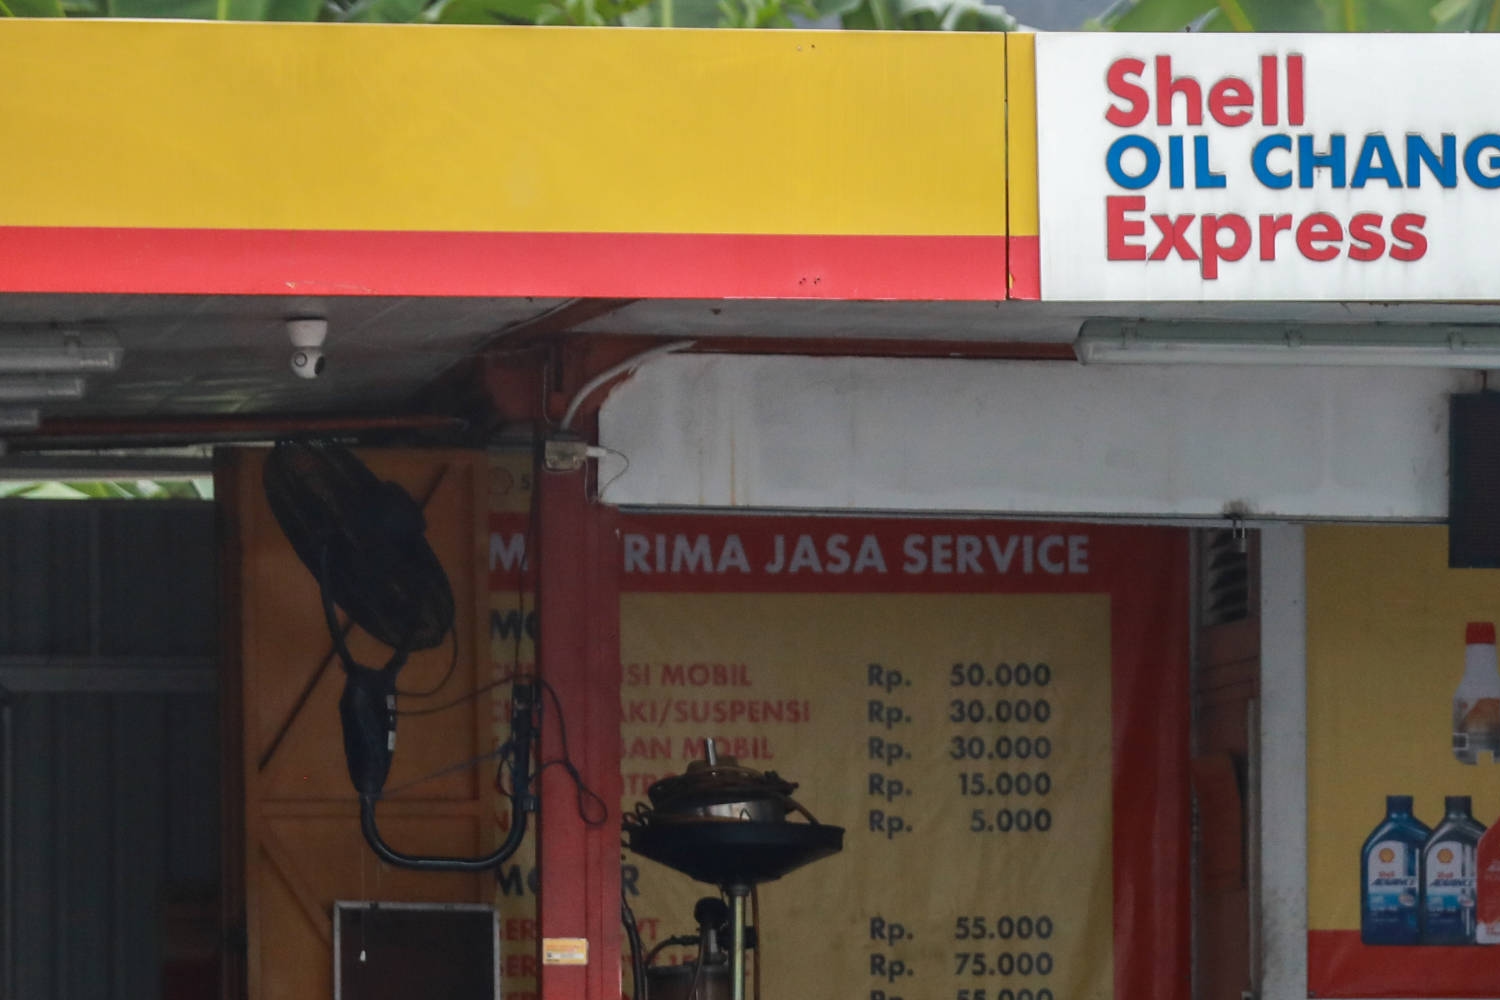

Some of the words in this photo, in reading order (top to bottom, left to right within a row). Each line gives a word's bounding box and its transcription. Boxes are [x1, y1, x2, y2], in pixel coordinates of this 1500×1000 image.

[1105, 54, 1304, 127] Shell
[1106, 134, 1227, 190] OIL
[1106, 195, 1428, 280] Express
[765, 533, 888, 574] JASA
[902, 533, 1090, 575] SERVICE
[660, 663, 753, 688] MOBIL
[867, 662, 912, 693] Rp.
[950, 662, 1051, 688] 50.000
[867, 700, 912, 730] Rp.
[950, 699, 1051, 724] 30.000
[867, 736, 912, 767] Rp.
[950, 736, 1052, 761] 30.000
[868, 772, 913, 803] Rp.
[958, 772, 1052, 797] 15.000
[868, 808, 913, 840] Rp.
[969, 808, 1052, 833] 5.000
[869, 915, 914, 946] Rp.
[955, 915, 1054, 941] 55.000
[869, 952, 914, 983] Rp.
[953, 951, 1054, 977] 75.000
